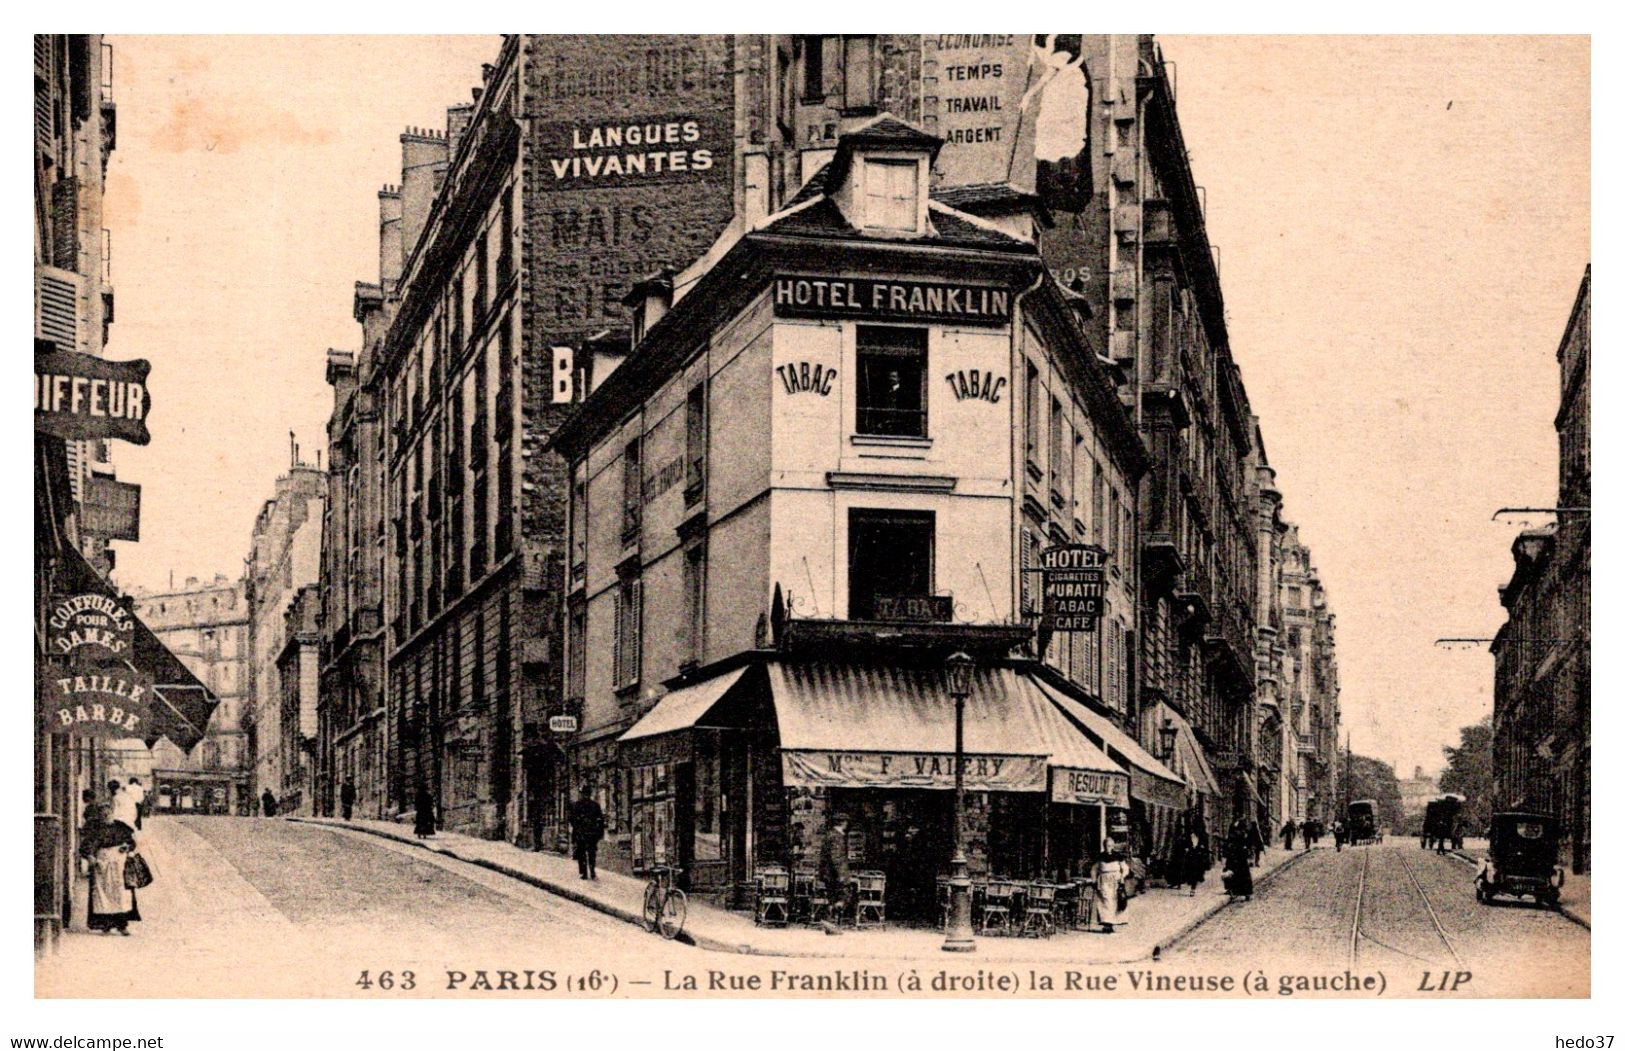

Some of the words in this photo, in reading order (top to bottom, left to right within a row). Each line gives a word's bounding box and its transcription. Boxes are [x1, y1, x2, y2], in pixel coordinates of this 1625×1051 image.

[946, 64, 1002, 81] TEMPS
[946, 96, 1002, 113] TRAVAIL
[573, 121, 700, 150] LANGUES
[946, 127, 1002, 144] ARGENT
[551, 150, 713, 179] VIVANTES
[777, 279, 862, 309] HOTEL
[872, 283, 1008, 317] FRANKLIN
[776, 361, 837, 397] TABAC
[946, 369, 1007, 404] TABAC
[1045, 550, 1102, 568] HOTEL
[1046, 583, 1102, 598] MURATTI
[50, 594, 134, 632] COIFFURES
[76, 614, 108, 626] POUR
[1056, 617, 1090, 630] CAFE
[56, 627, 127, 653] DAMES
[57, 675, 145, 703] TAILLE
[58, 703, 140, 731] BARBE
[552, 718, 575, 728] HOTEL
